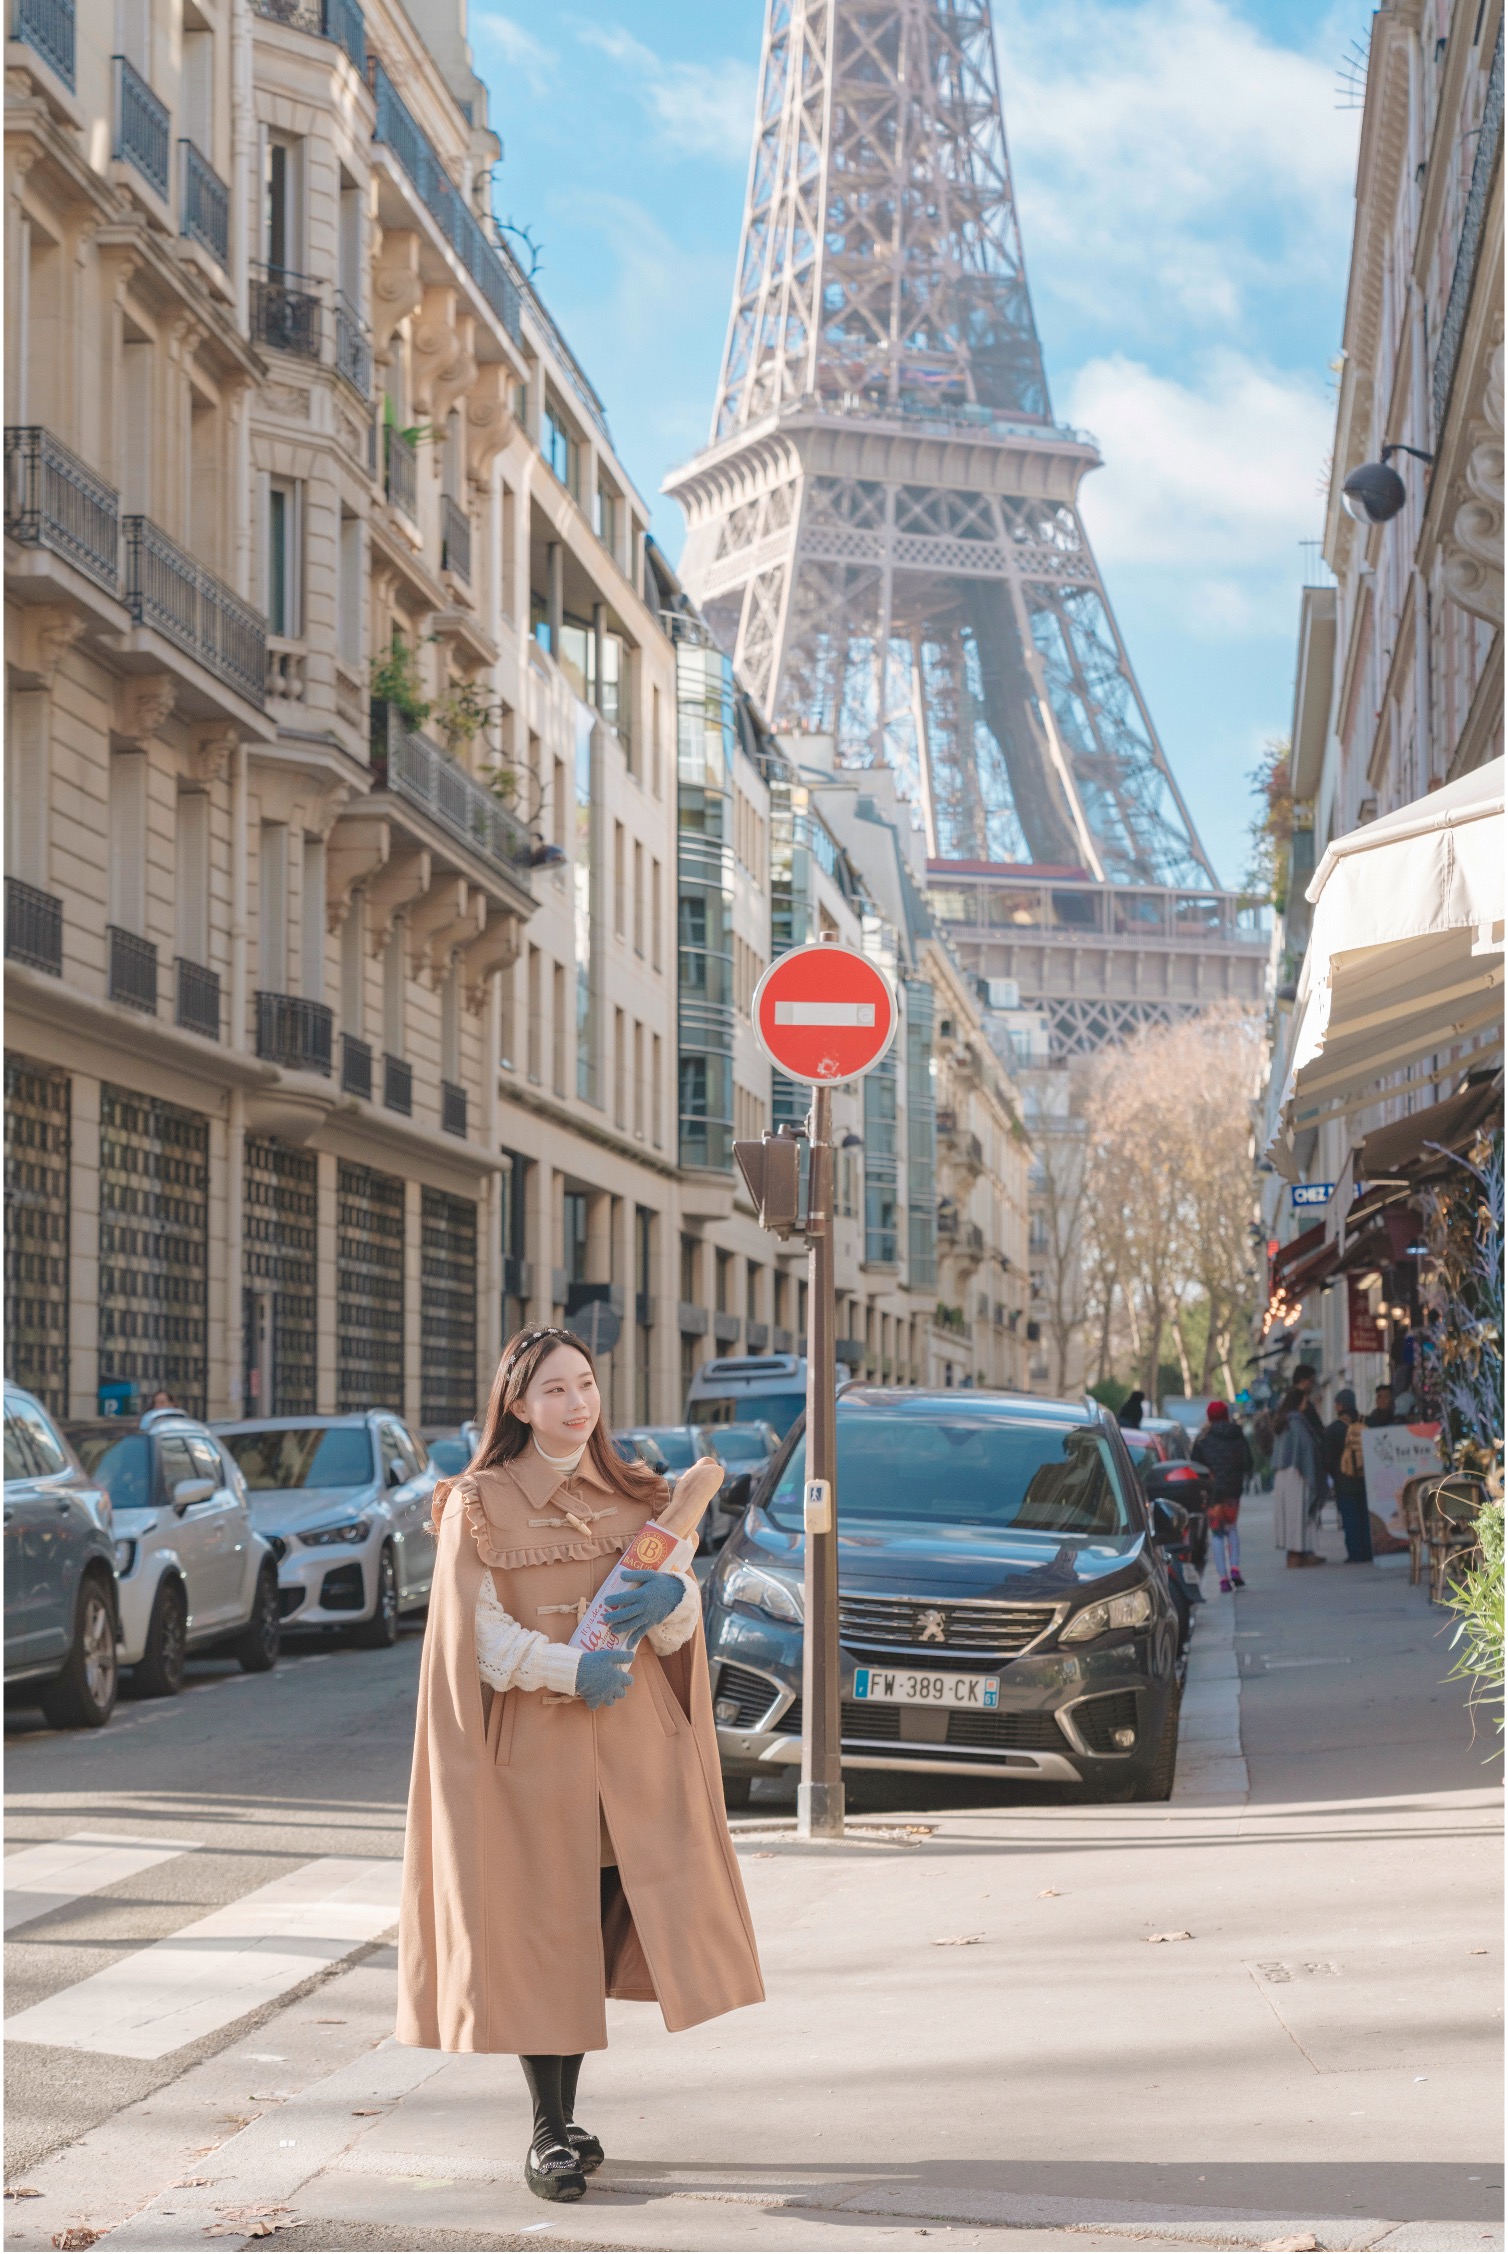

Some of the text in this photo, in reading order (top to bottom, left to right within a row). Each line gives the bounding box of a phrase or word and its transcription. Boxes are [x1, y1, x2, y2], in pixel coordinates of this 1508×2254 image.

[1294, 1186, 1327, 1203] CHEZ
[642, 1539, 659, 1559] B
[580, 1630, 602, 1652] la
[870, 1673, 980, 1703] FW-389-CK
[985, 1693, 997, 1705] 61
